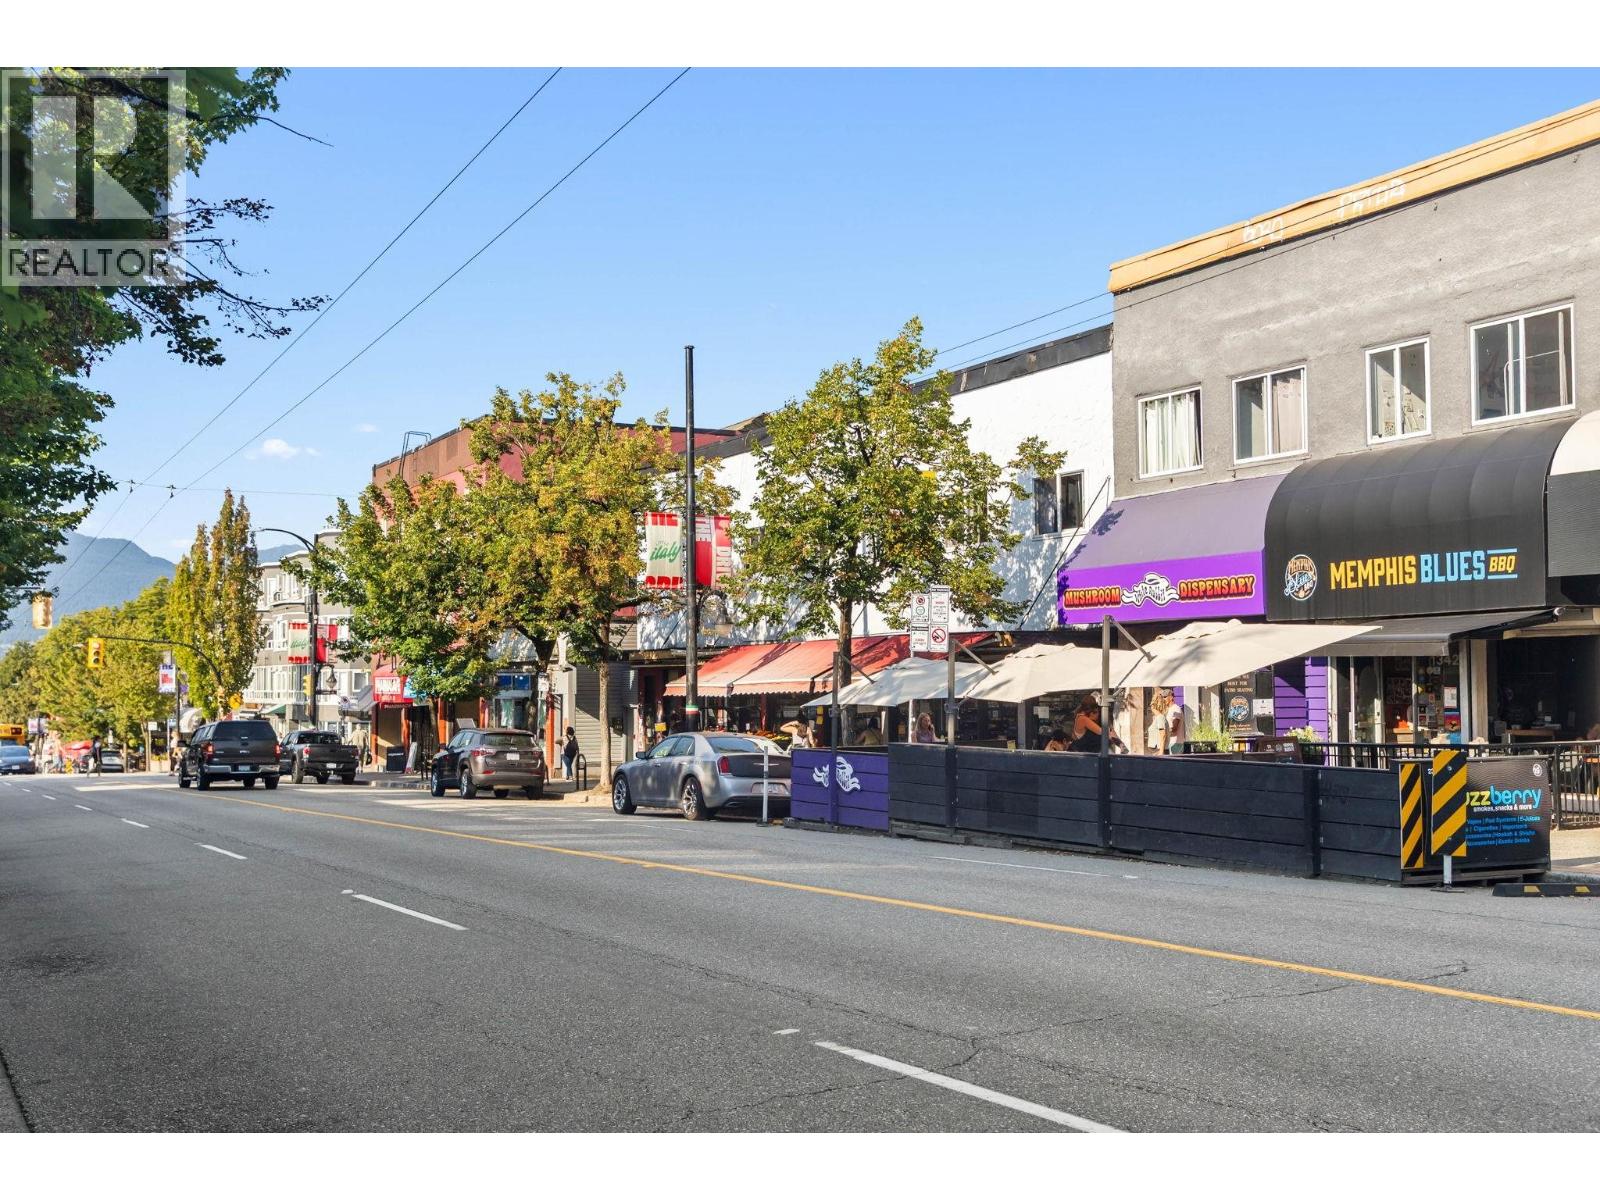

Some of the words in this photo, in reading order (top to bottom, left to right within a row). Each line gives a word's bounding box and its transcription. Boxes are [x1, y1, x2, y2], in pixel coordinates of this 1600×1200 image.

[650, 541, 682, 563] italy
[1330, 555, 1416, 590] MEMPHIS
[1420, 550, 1485, 584] BLUES
[1489, 555, 1516, 573] BBQ
[1064, 586, 1122, 608] MUSHROOM
[1178, 575, 1256, 601] DISPENSARY
